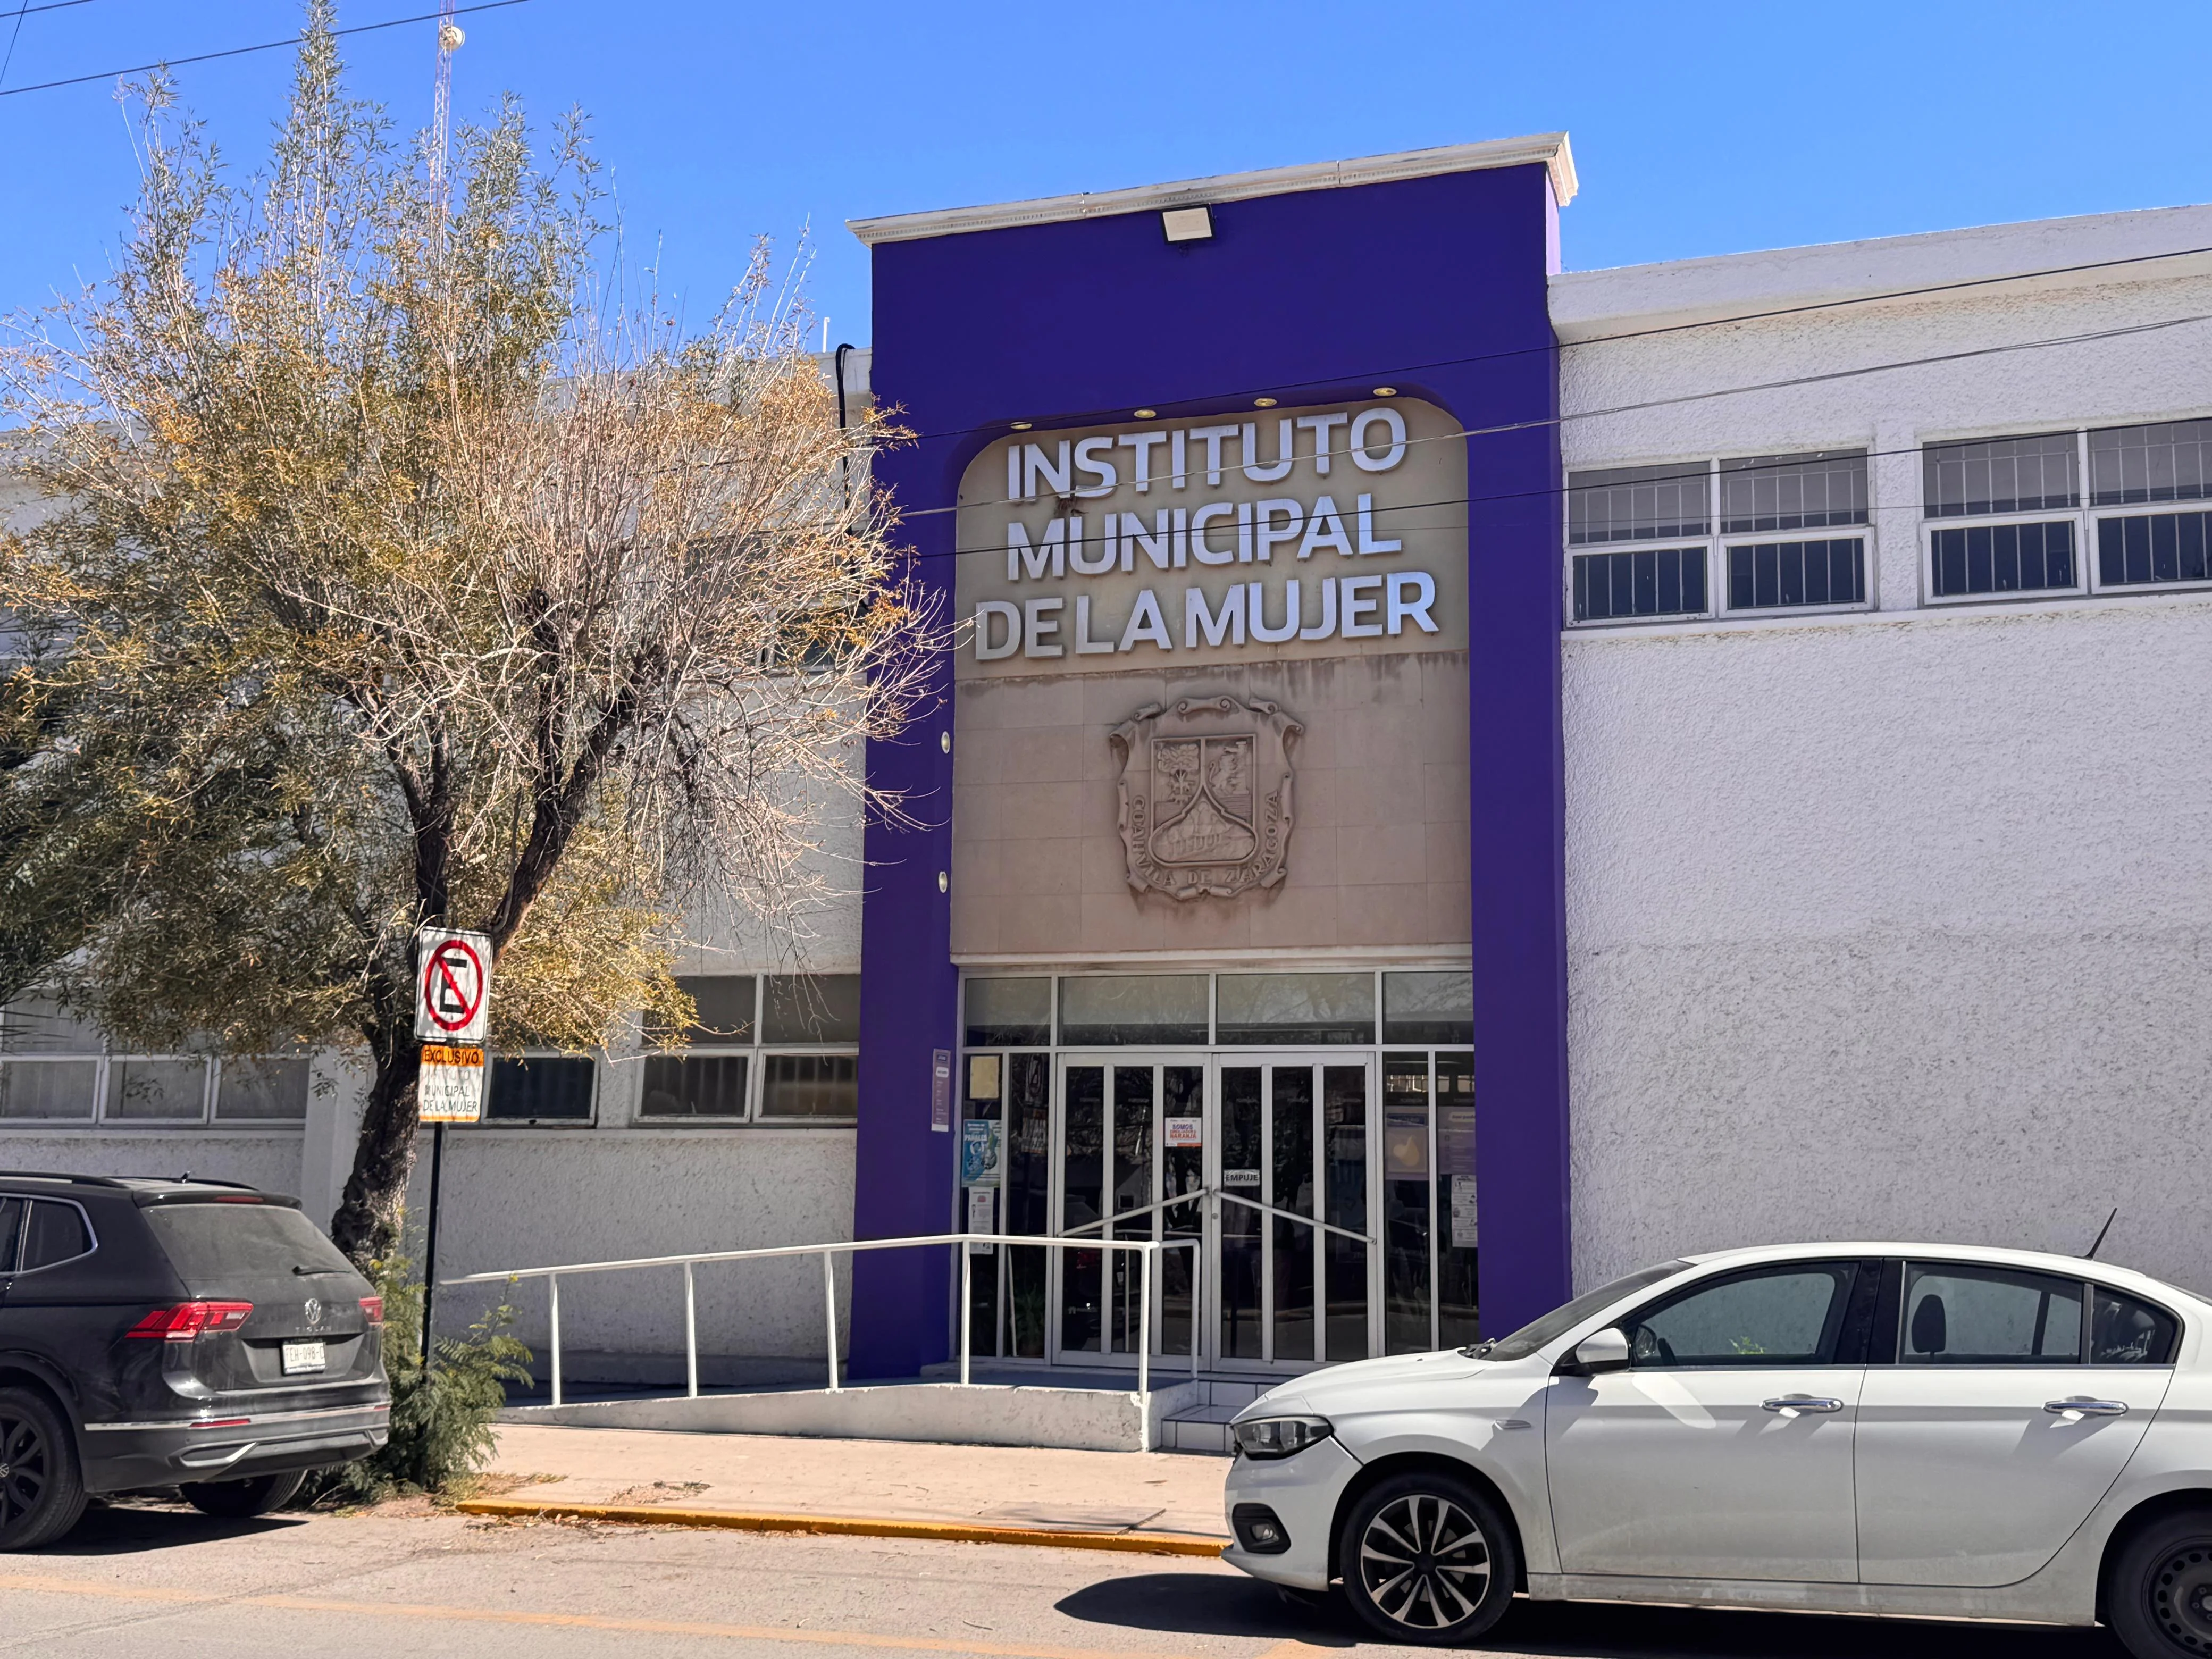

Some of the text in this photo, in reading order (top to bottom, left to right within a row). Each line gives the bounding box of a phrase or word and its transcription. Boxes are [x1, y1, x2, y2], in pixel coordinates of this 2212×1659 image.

[1008, 407, 1406, 501] INSTITUTO
[1008, 493, 1402, 581] MUNICIPAL
[975, 571, 1439, 660] DE LA MUJER
[1188, 870, 1212, 884] DE
[1225, 791, 1278, 883] ZARAGOZA
[424, 1049, 480, 1065] EXCLUSIVO
[425, 1085, 470, 1097] MUNICIPAL
[423, 1099, 477, 1113] DE LA MUJER
